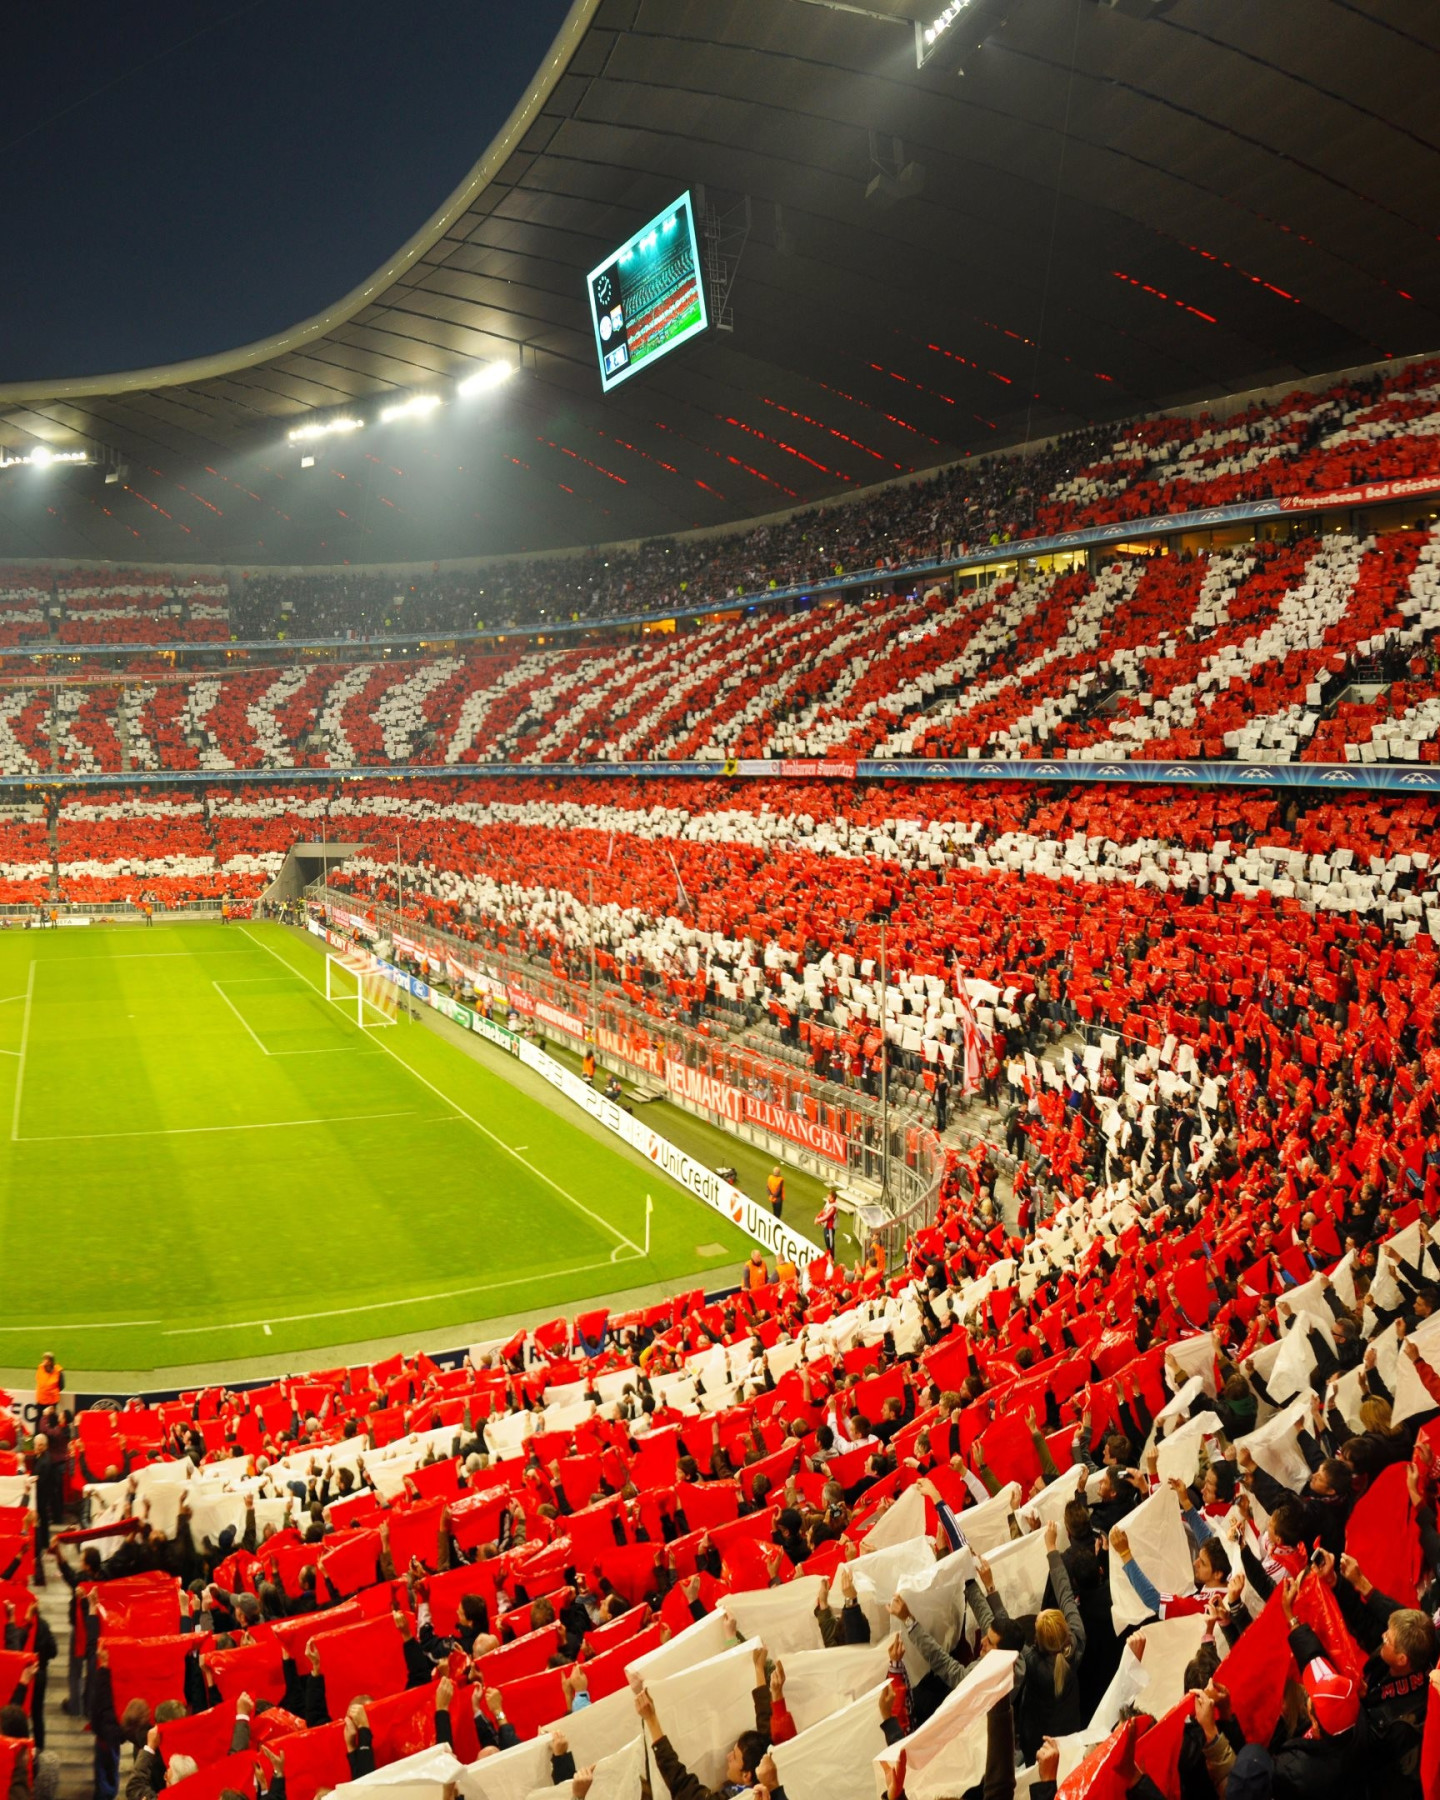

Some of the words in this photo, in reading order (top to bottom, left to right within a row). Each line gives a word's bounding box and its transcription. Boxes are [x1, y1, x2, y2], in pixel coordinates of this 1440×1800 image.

[1365, 485, 1389, 499] Bad
[586, 1088, 620, 1131] PS3
[665, 1059, 742, 1122] NEUMARKT
[747, 1098, 845, 1159] ELLWANGEN
[661, 1142, 720, 1206] UniCredit
[747, 1203, 820, 1269] UniCredi
